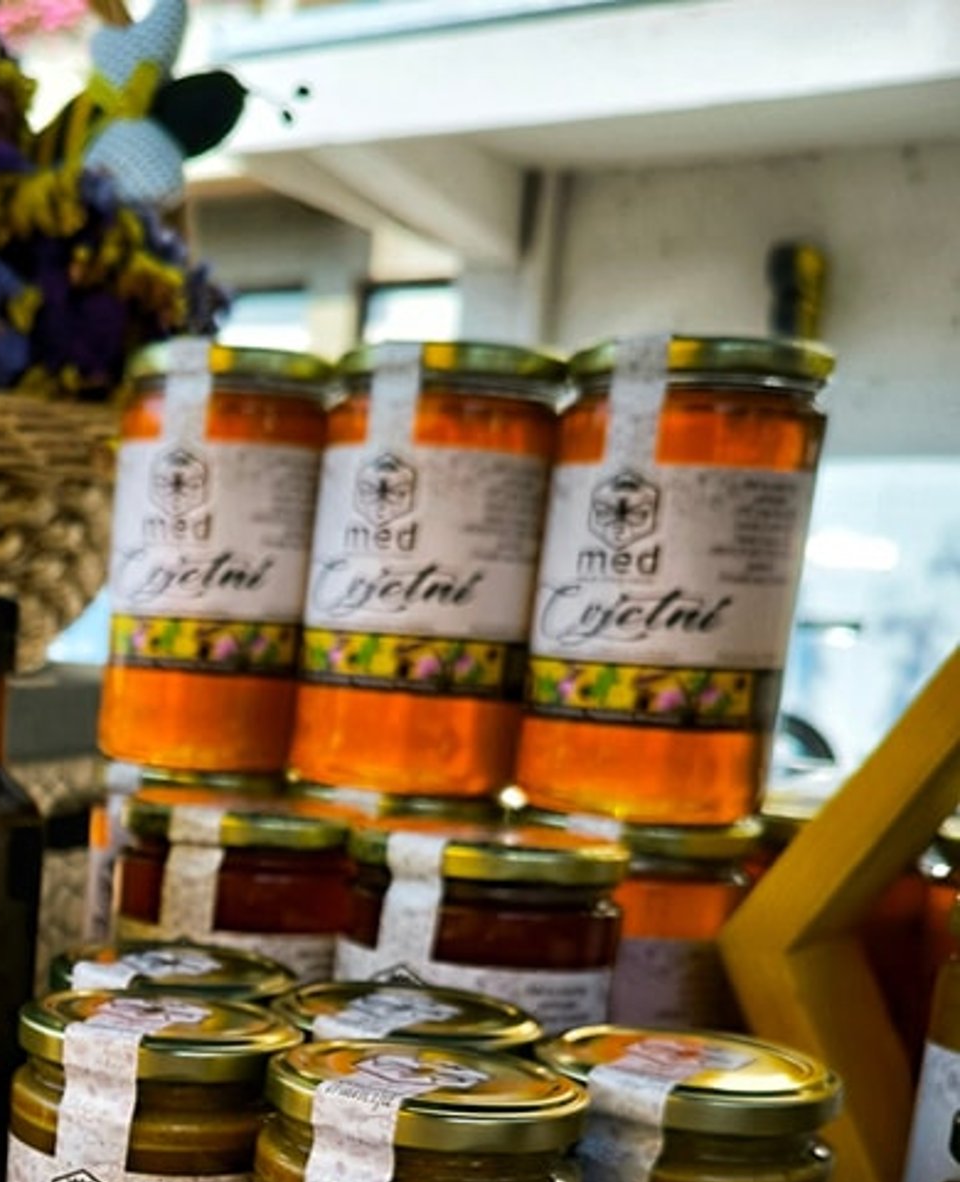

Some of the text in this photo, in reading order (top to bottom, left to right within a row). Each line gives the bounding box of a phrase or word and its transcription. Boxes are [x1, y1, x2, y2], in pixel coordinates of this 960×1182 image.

[143, 514, 212, 540] med
[345, 521, 418, 551] med
[577, 545, 660, 575] med
[541, 584, 732, 646] Cvjetni
